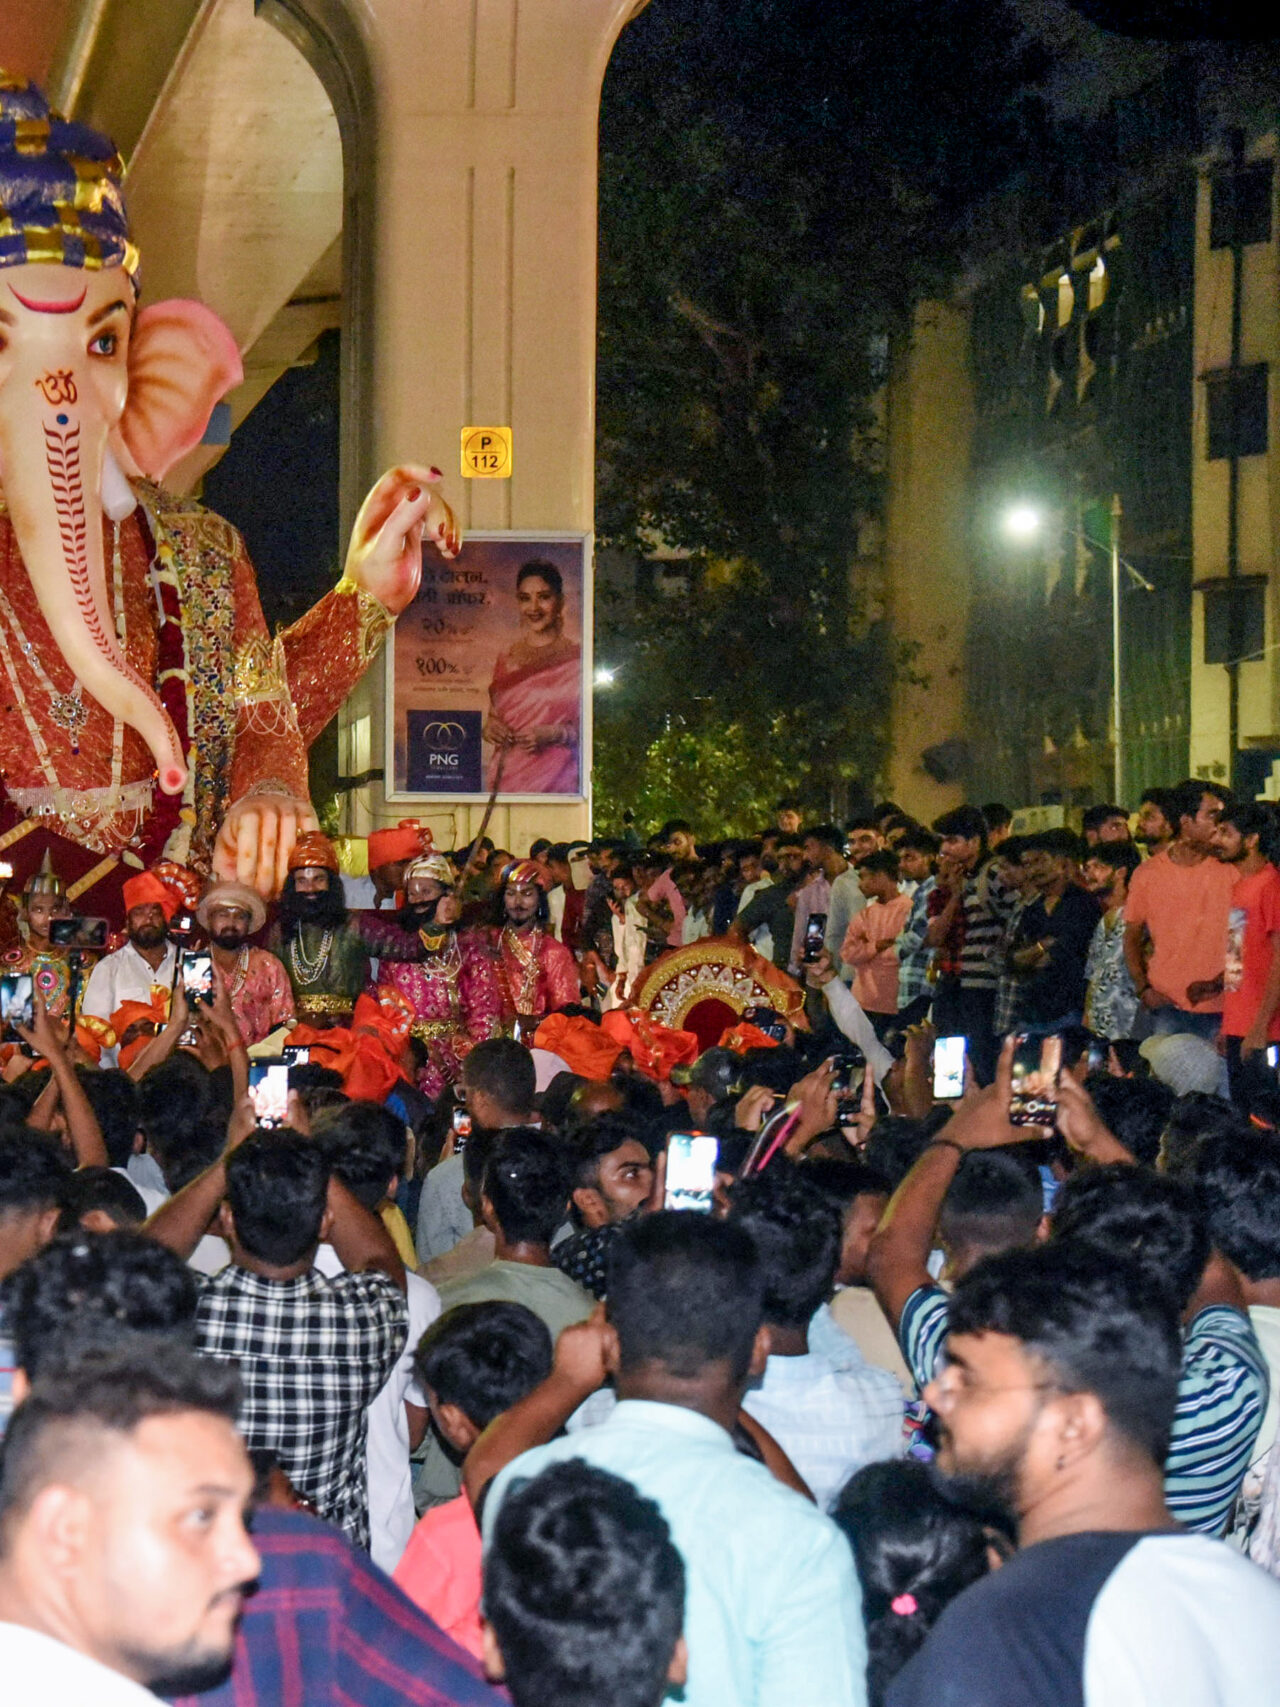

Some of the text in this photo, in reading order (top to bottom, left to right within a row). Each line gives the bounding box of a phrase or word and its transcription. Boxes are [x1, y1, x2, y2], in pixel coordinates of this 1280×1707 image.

[481, 436, 492, 450] P
[471, 455, 499, 468] 112
[429, 754, 459, 766] PNG
